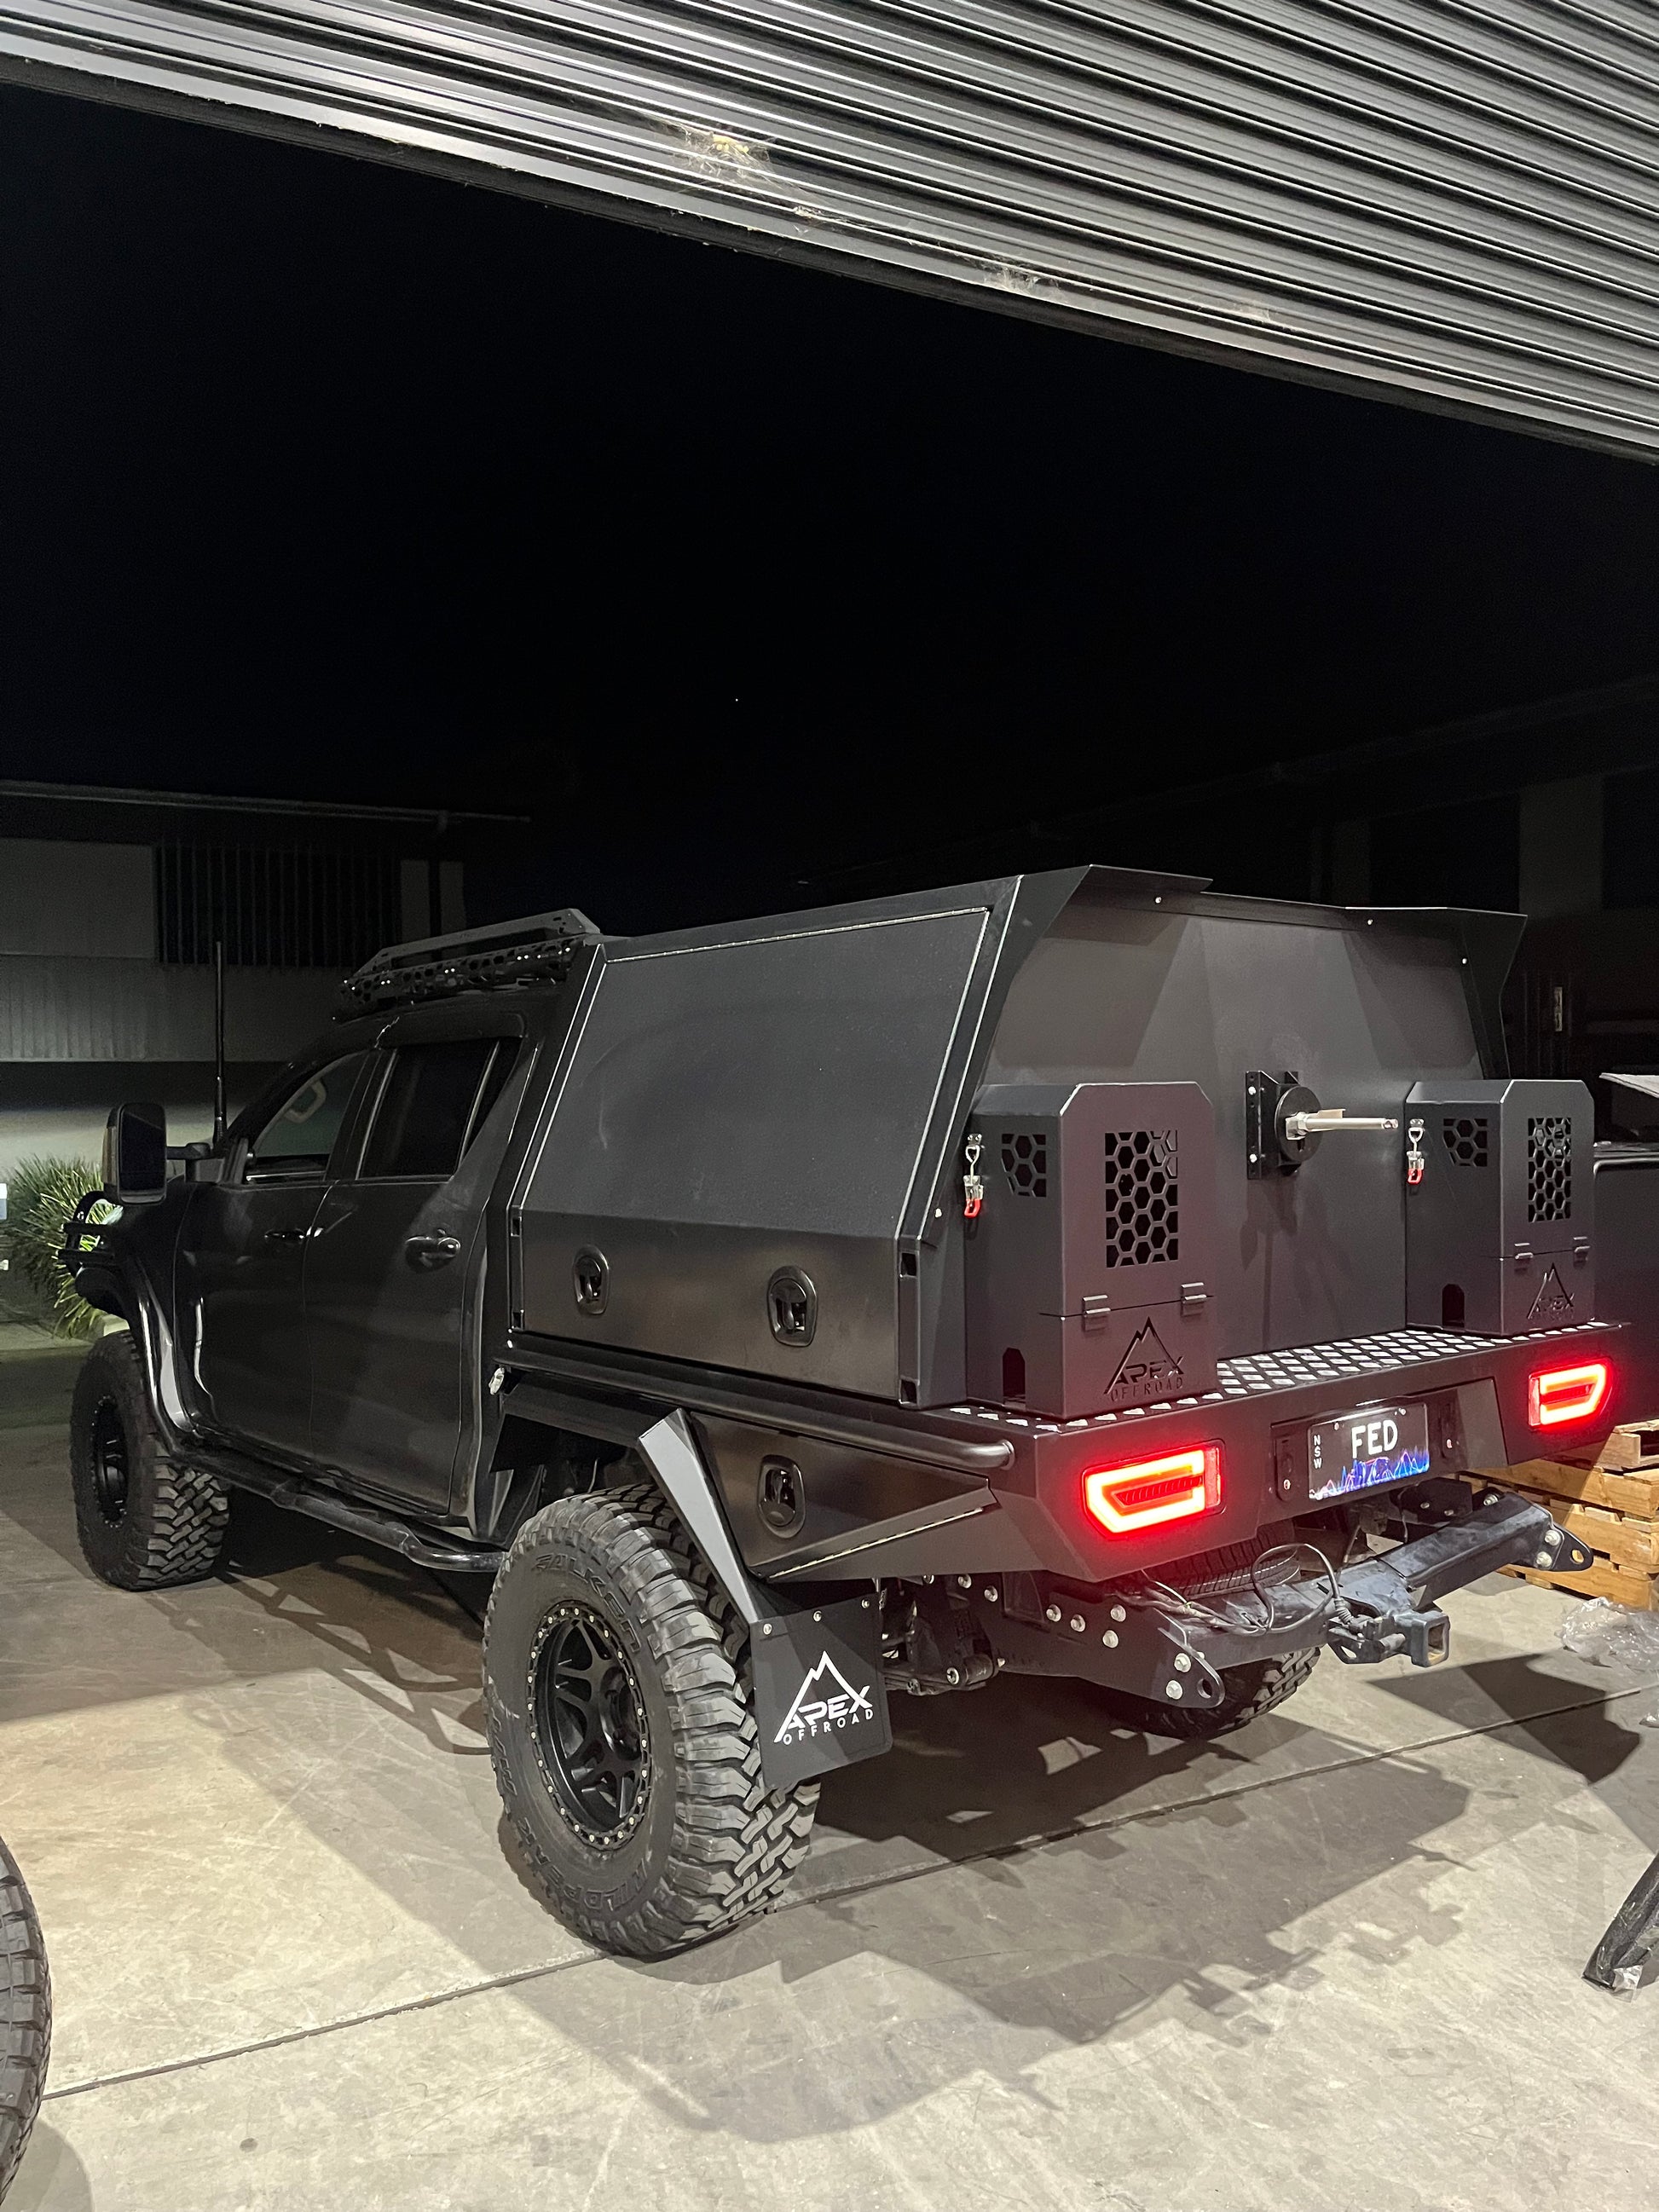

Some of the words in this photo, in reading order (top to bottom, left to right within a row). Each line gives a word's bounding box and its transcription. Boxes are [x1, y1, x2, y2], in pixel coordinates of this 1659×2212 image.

[1103, 1316, 1184, 1395] APEX
[1110, 1377, 1183, 1402] OFFROAD
[1313, 1434, 1322, 1470] NSW
[1351, 1419, 1398, 1459] FED
[773, 1650, 873, 1743] APEX
[783, 1708, 874, 1746] OFFROAD
